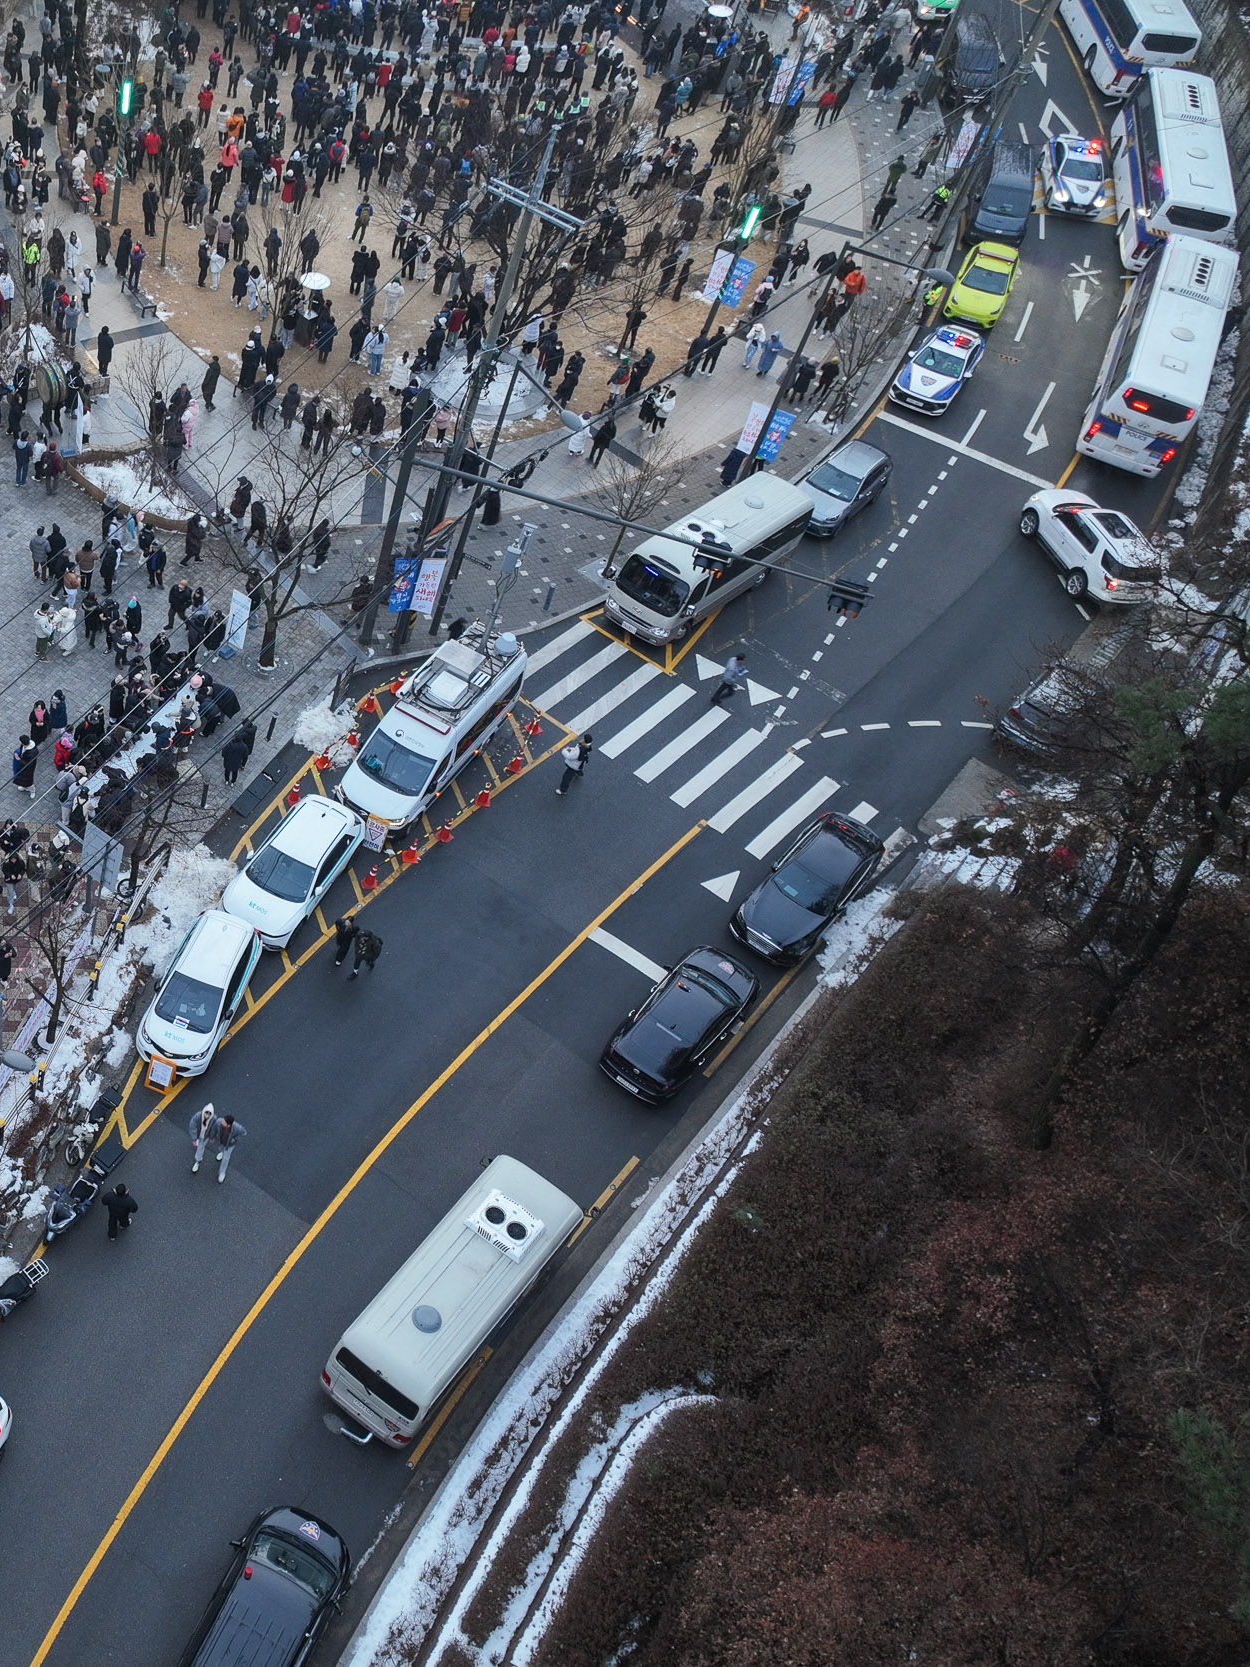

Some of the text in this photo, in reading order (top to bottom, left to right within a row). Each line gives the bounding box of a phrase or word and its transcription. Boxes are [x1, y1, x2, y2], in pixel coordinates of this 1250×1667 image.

[1126, 430, 1147, 441] POLICE
[415, 588, 436, 598] 새해
[369, 821, 385, 832] 공사중
